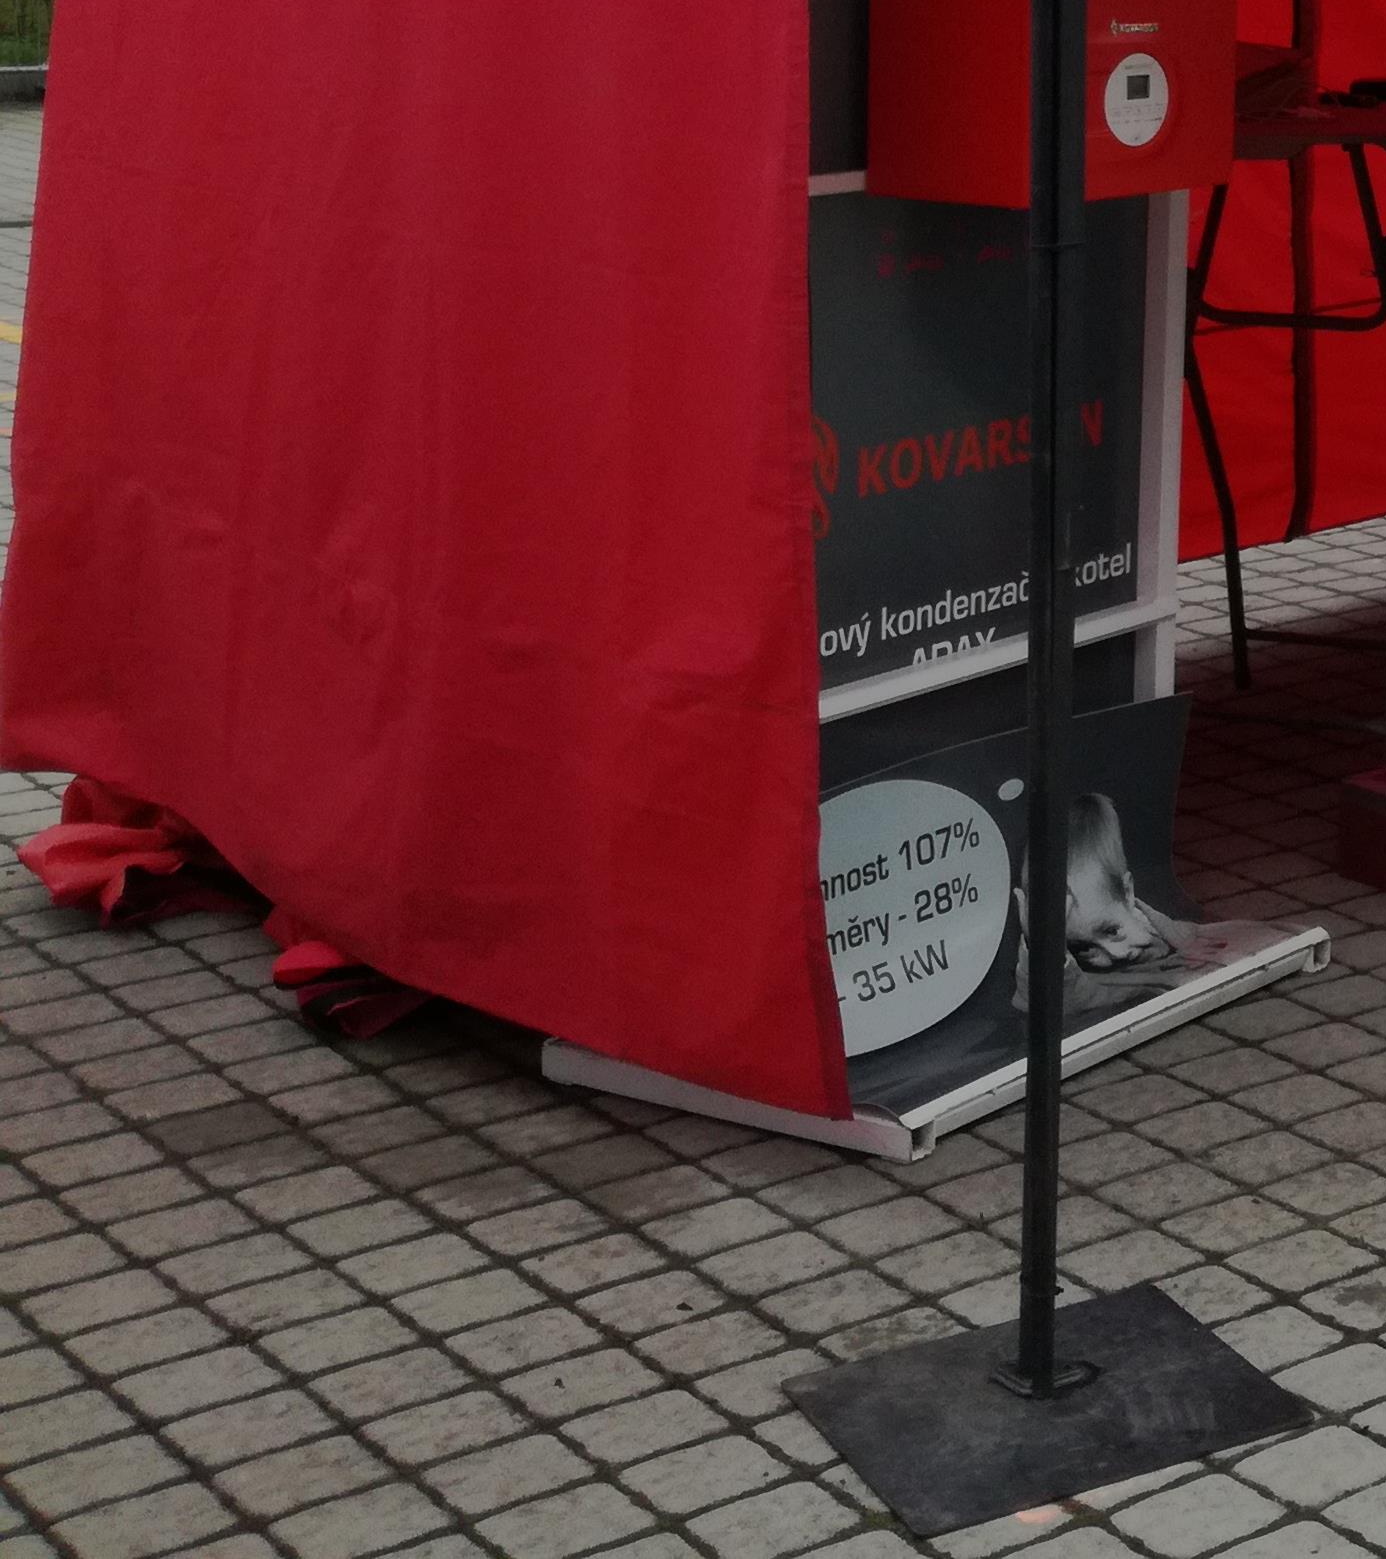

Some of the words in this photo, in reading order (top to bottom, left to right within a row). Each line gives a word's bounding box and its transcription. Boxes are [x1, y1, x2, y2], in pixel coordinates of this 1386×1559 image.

[856, 397, 1104, 500] KOVARSN
[819, 612, 871, 658] ový
[881, 570, 1030, 641] kondenzač
[898, 817, 980, 871] 107%
[826, 912, 890, 956] měry
[914, 873, 979, 923] 28%
[852, 961, 896, 1002] 35
[900, 939, 949, 984] kW
